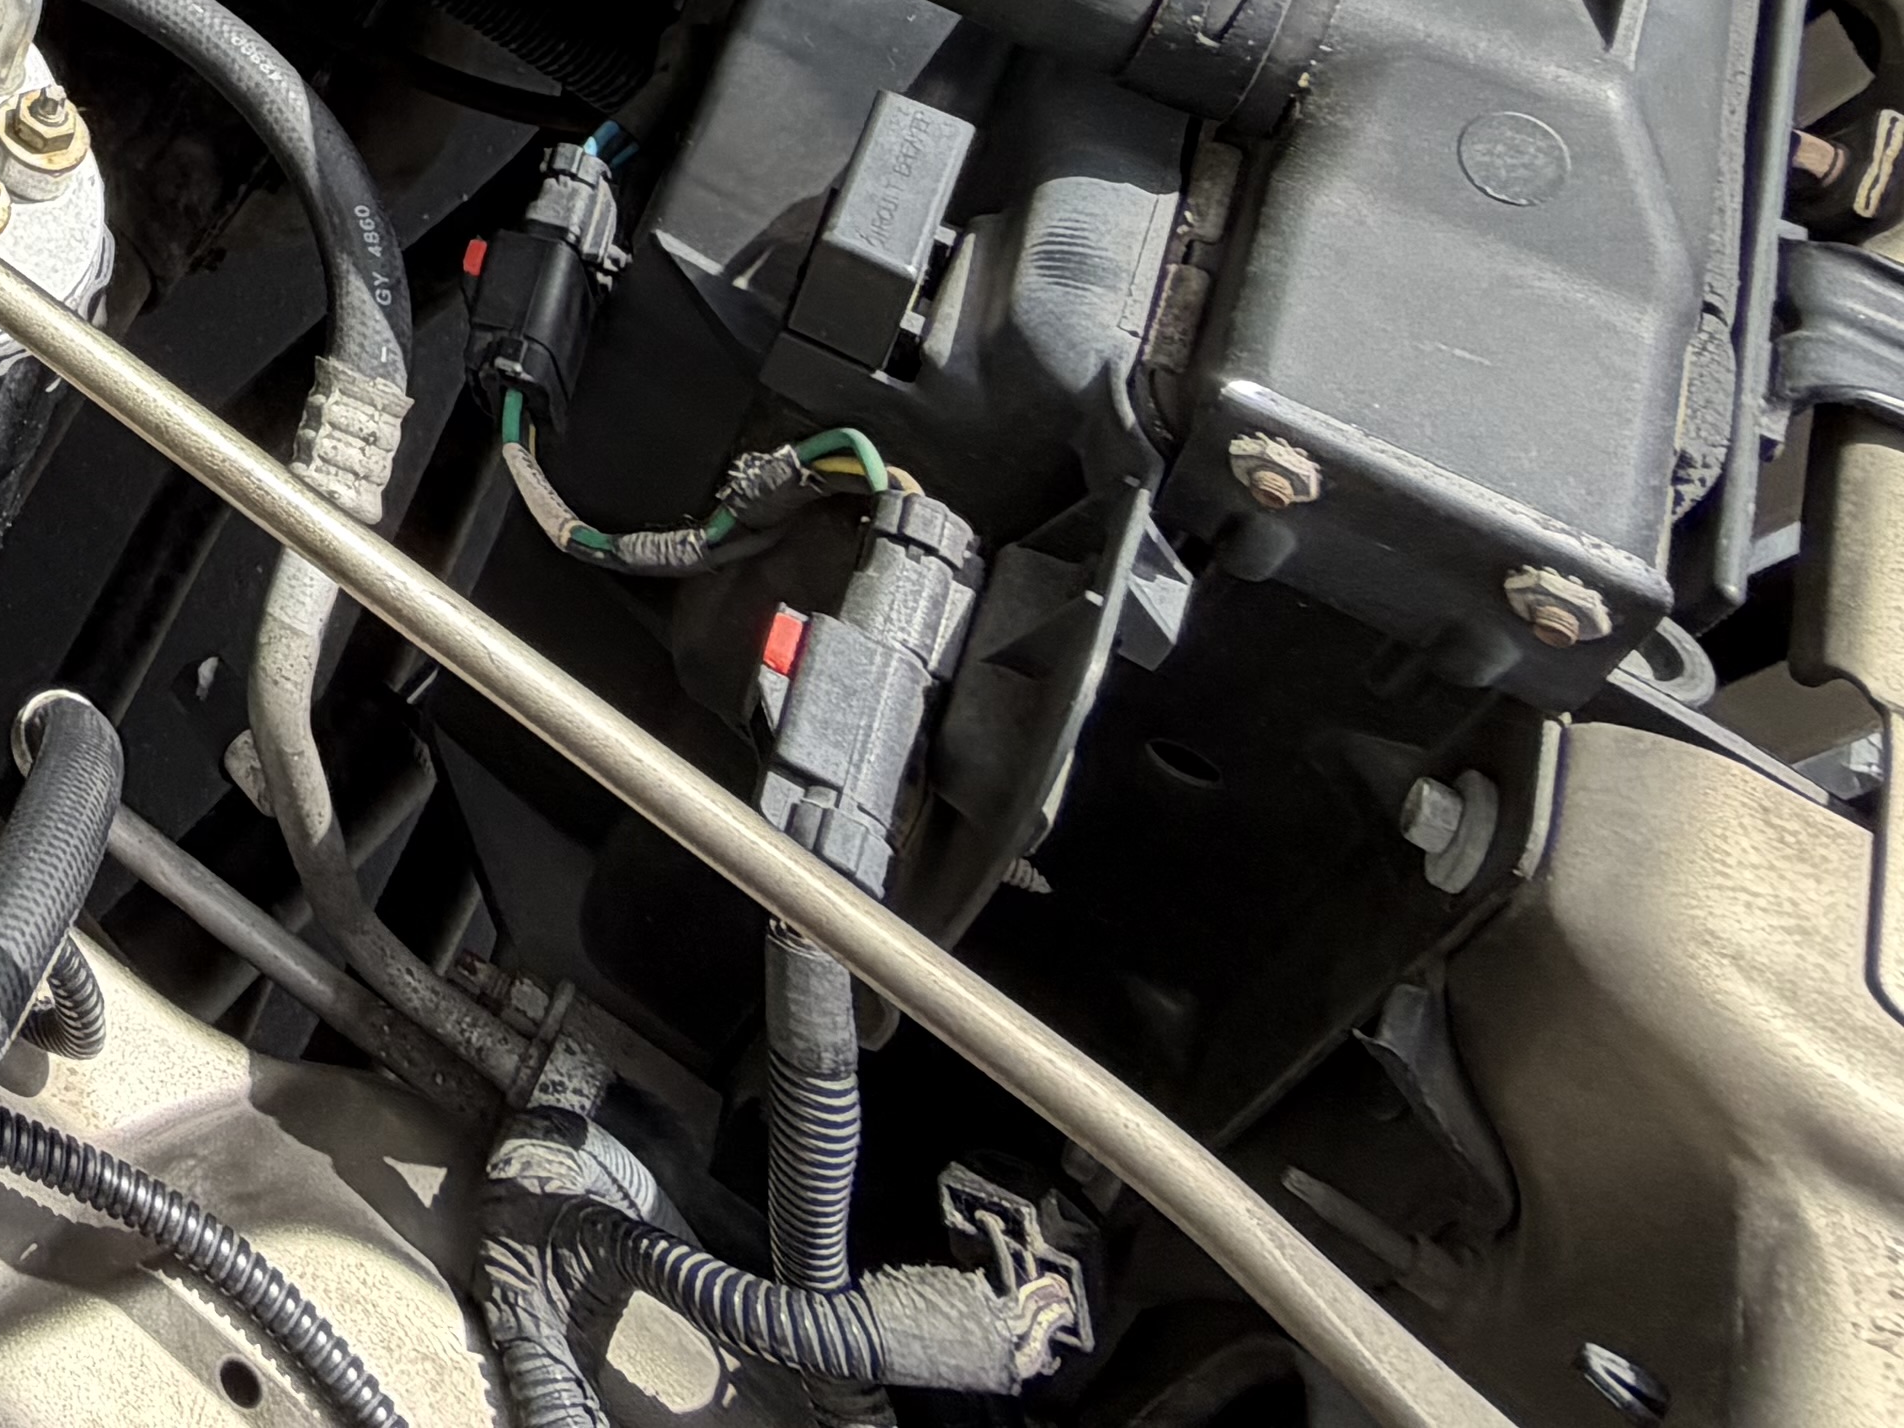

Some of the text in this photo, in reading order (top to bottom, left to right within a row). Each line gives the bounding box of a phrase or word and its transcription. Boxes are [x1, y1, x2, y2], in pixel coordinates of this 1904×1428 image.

[892, 110, 930, 177] BREAKER
[354, 205, 392, 306] GY 4860
